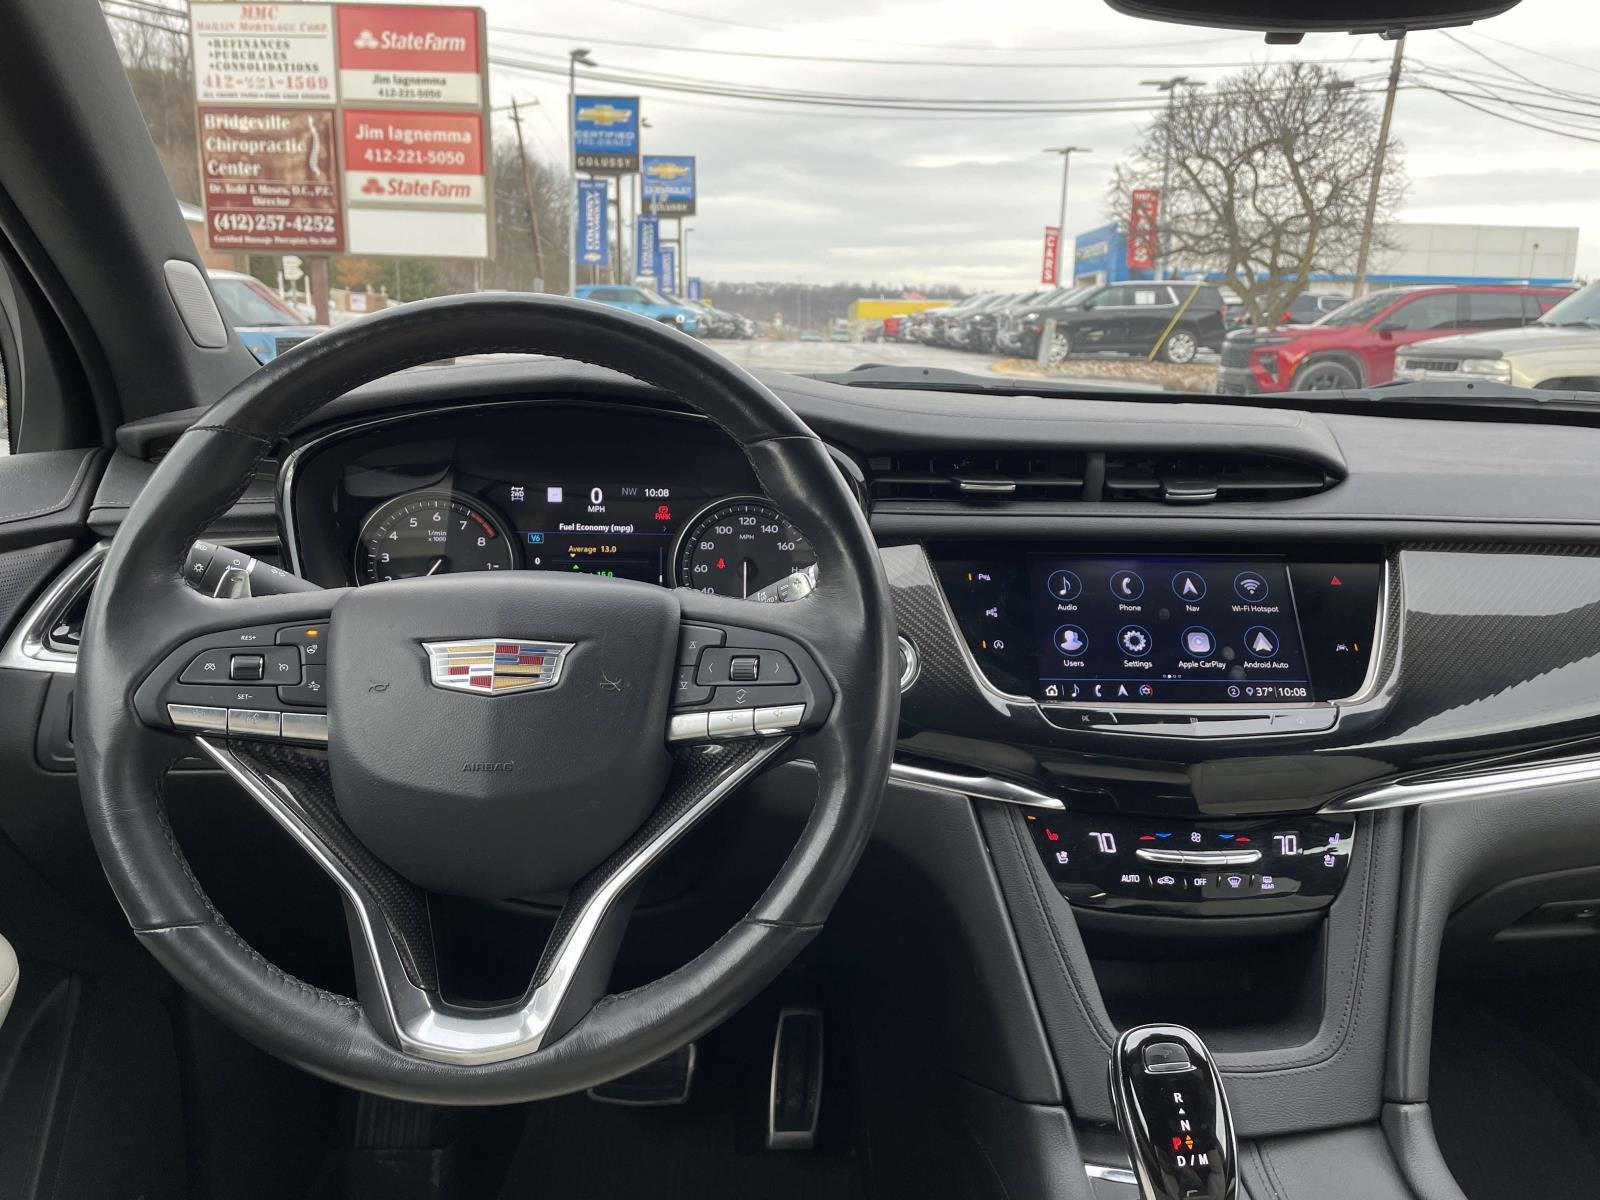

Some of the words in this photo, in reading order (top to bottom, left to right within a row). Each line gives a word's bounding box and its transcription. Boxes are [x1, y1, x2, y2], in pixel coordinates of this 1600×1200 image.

[213, 39, 290, 50] REFINANCES
[381, 31, 466, 52] StateFarm
[214, 50, 287, 60] PURCHASES
[214, 61, 319, 72] CONSOLIDATIONS
[372, 74, 389, 86] Jim
[392, 75, 447, 88] Iagnemma
[204, 114, 290, 134] Bridgeville
[355, 124, 384, 141] Jim
[388, 125, 472, 145] Iagnemma
[205, 136, 305, 155] Chiropractic
[364, 148, 465, 165] 412-221-5050
[207, 159, 262, 177] Center
[388, 178, 471, 199] StateFarm
[252, 196, 290, 207] Director
[214, 213, 254, 233] (412)
[255, 215, 335, 233] 257-4252
[590, 487, 603, 504] 0
[622, 488, 637, 496] NW
[644, 488, 670, 498] 10:08
[433, 512, 441, 522] 6
[739, 517, 756, 526] 120
[409, 518, 418, 527] 5
[459, 521, 467, 530] 7
[559, 523, 575, 531] Fuel
[576, 523, 610, 533] Economy
[611, 524, 634, 533] (mpg)
[715, 526, 733, 535] 100
[760, 525, 779, 533] 140
[389, 531, 398, 540] 4
[477, 537, 486, 547] 8
[700, 542, 715, 550] 80
[777, 542, 795, 551] 160
[568, 545, 597, 554] Average
[381, 553, 390, 562] 3
[694, 565, 708, 573] 60
[1119, 604, 1142, 612] Phone
[1251, 605, 1280, 614] Hotspot
[1124, 660, 1153, 669] Settings
[1178, 661, 1199, 669] Apple
[1200, 661, 1227, 670] CarPlay
[1244, 661, 1271, 669] Android
[1256, 686, 1273, 697] 37°
[1278, 687, 1307, 697] 10:08
[462, 761, 514, 772] AIRBAG
[1088, 832, 1117, 854] 70
[1273, 834, 1297, 855] 70
[1121, 874, 1140, 883] AUTO
[1193, 878, 1207, 886] OFF
[1173, 1092, 1184, 1103] R
[1180, 1119, 1191, 1132] N
[1172, 1136, 1182, 1150] P
